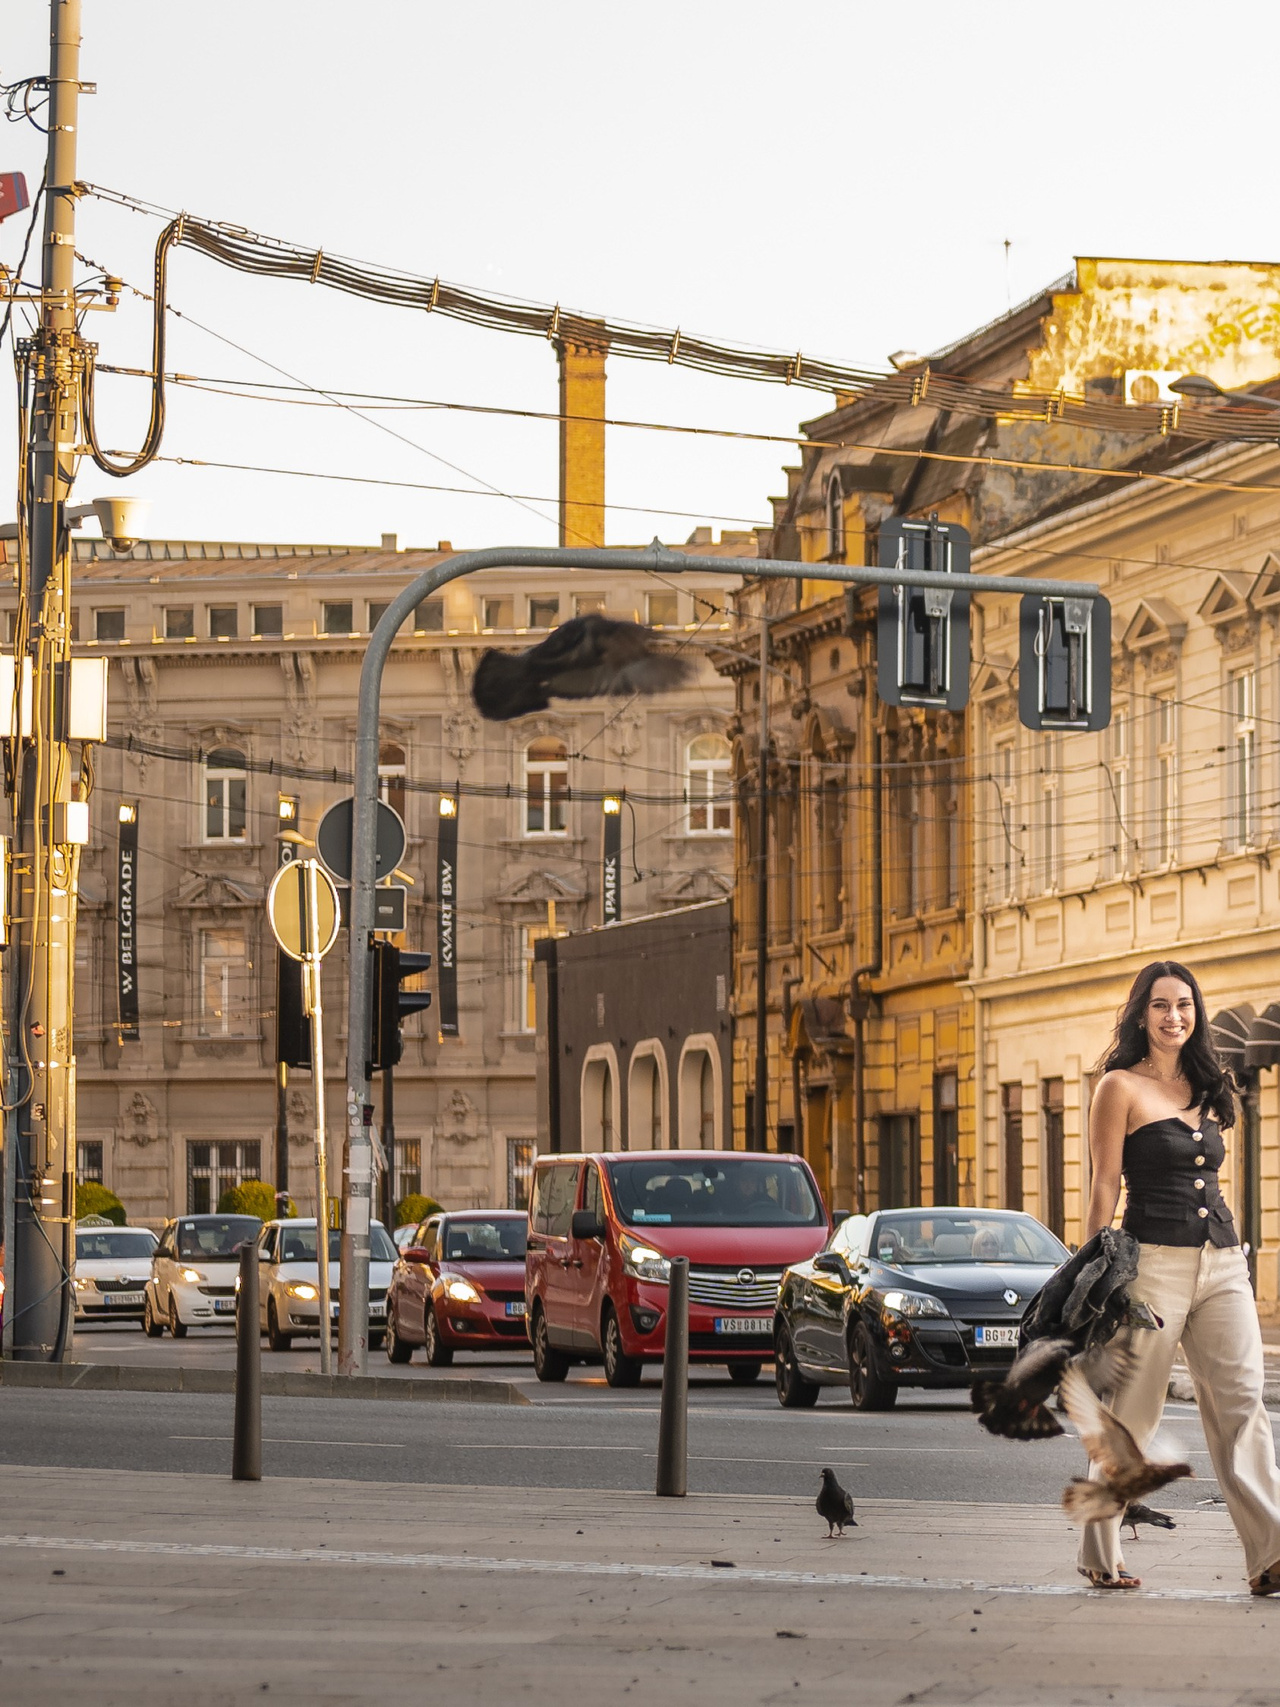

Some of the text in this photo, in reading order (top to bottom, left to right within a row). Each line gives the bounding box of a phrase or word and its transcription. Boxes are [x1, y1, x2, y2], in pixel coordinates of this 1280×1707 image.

[121, 850, 133, 994] W BELGRADE
[441, 859, 453, 968] KVART BW
[605, 857, 617, 914] PARK
[985, 1329, 999, 1341] BG
